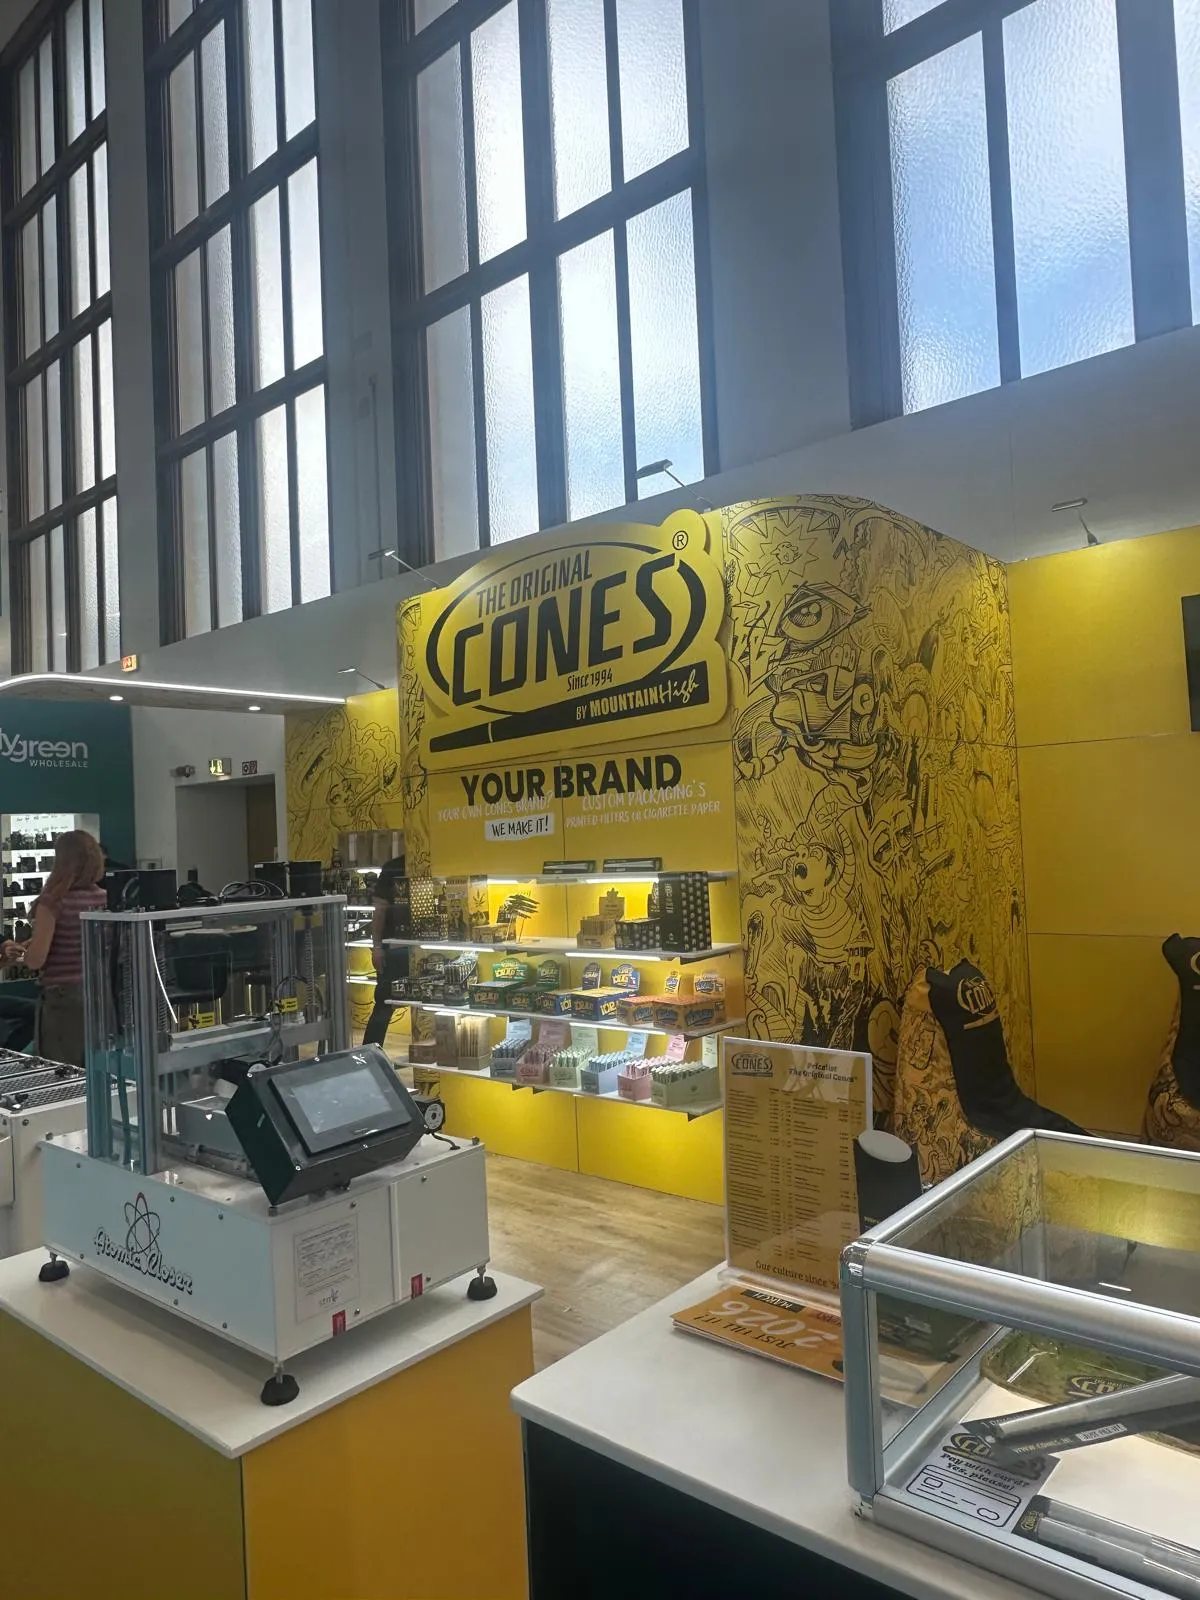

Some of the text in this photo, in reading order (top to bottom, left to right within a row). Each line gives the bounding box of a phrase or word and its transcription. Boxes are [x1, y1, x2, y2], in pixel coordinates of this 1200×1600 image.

[477, 550, 593, 618] THE ORIGINAL
[452, 553, 676, 707] CONES
[567, 668, 613, 692] Since 1994
[576, 705, 587, 720] BY
[590, 685, 659, 718] MOUNTAIN
[29, 759, 89, 768] WHOLESALE
[460, 754, 682, 807] YOUR BRAND
[582, 792, 624, 811] CUSTOM
[644, 803, 688, 820] CIGARETTE
[691, 800, 720, 815] PAPER
[492, 815, 549, 837] WE MAKE IT!
[735, 1056, 769, 1070] CONES
[755, 1260, 771, 1271] Our
[772, 1266, 804, 1281] culture
[805, 1274, 828, 1287] since
[693, 1314, 796, 1349] JUST FILL IT!
[710, 1300, 839, 1348] 2026
[941, 1452, 964, 1465] Pay
[964, 1461, 992, 1475] with
[946, 1462, 967, 1475] Yes,
